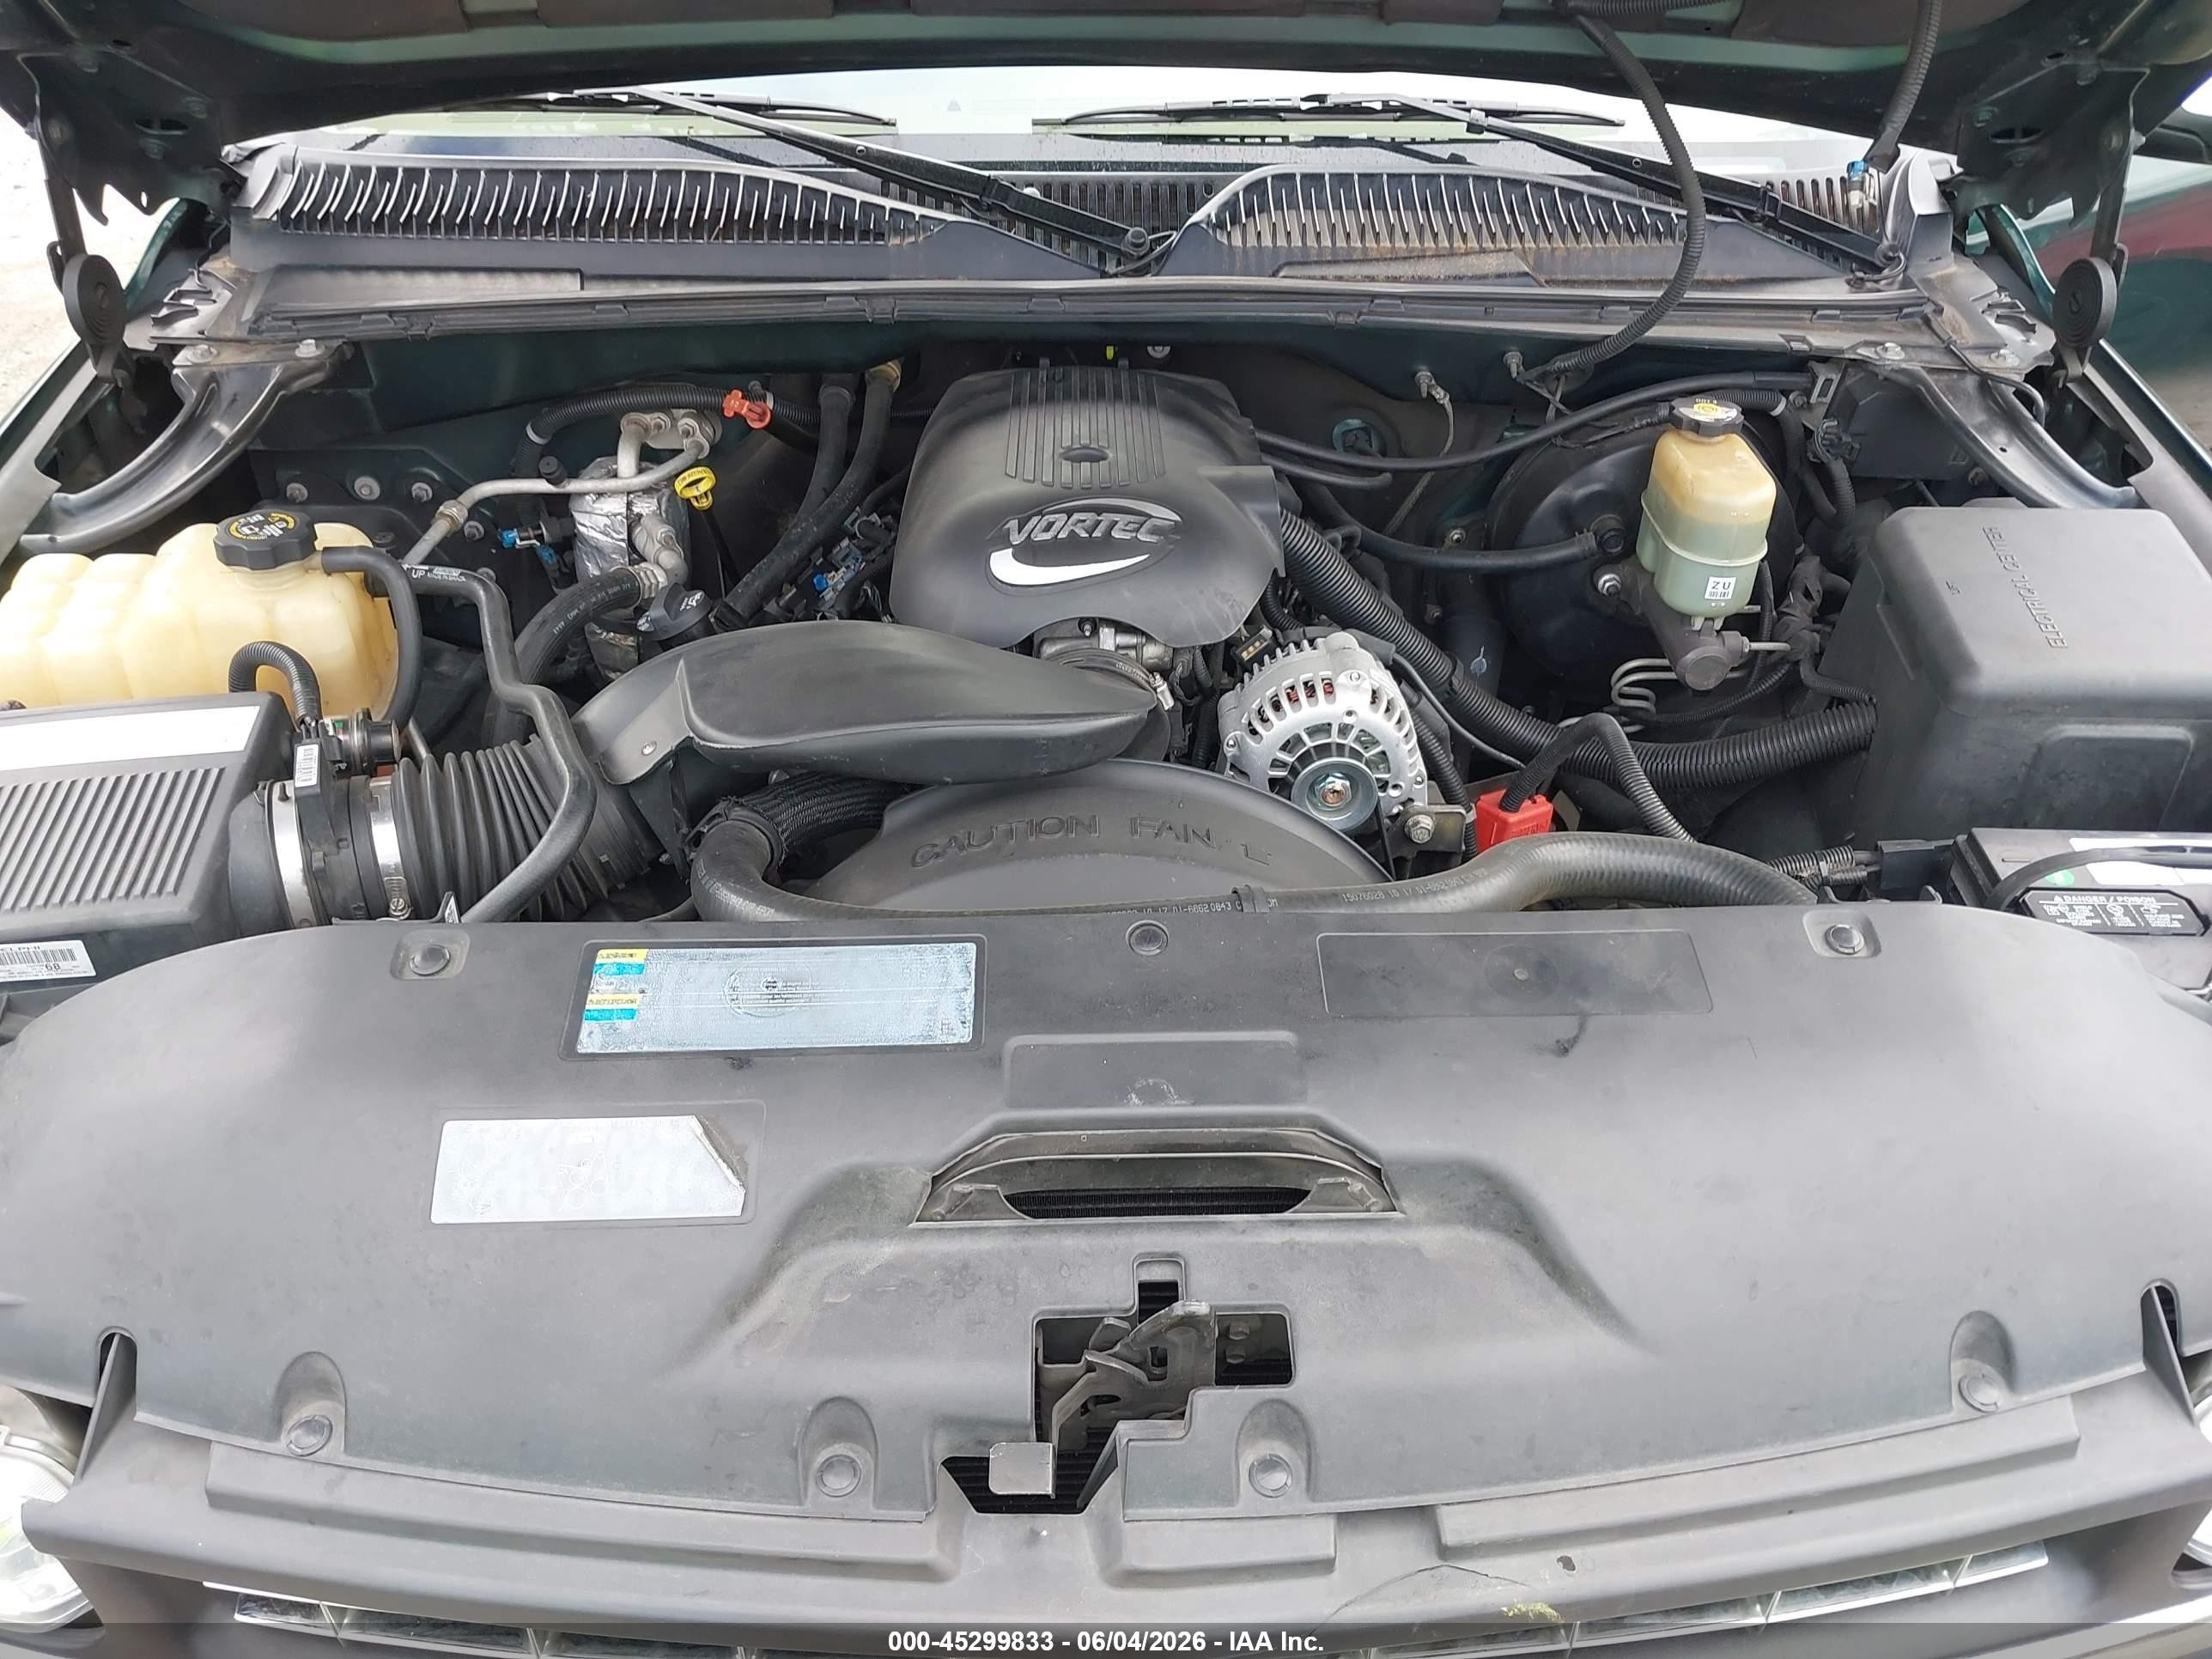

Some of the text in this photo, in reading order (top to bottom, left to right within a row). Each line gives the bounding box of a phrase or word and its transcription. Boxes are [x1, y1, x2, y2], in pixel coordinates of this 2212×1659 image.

[1003, 512, 1176, 545] VORTEC
[411, 568, 426, 579] UP
[910, 813, 1100, 868] CAUTION
[1130, 817, 1217, 850] FAN
[2063, 895, 2107, 903] DANGER
